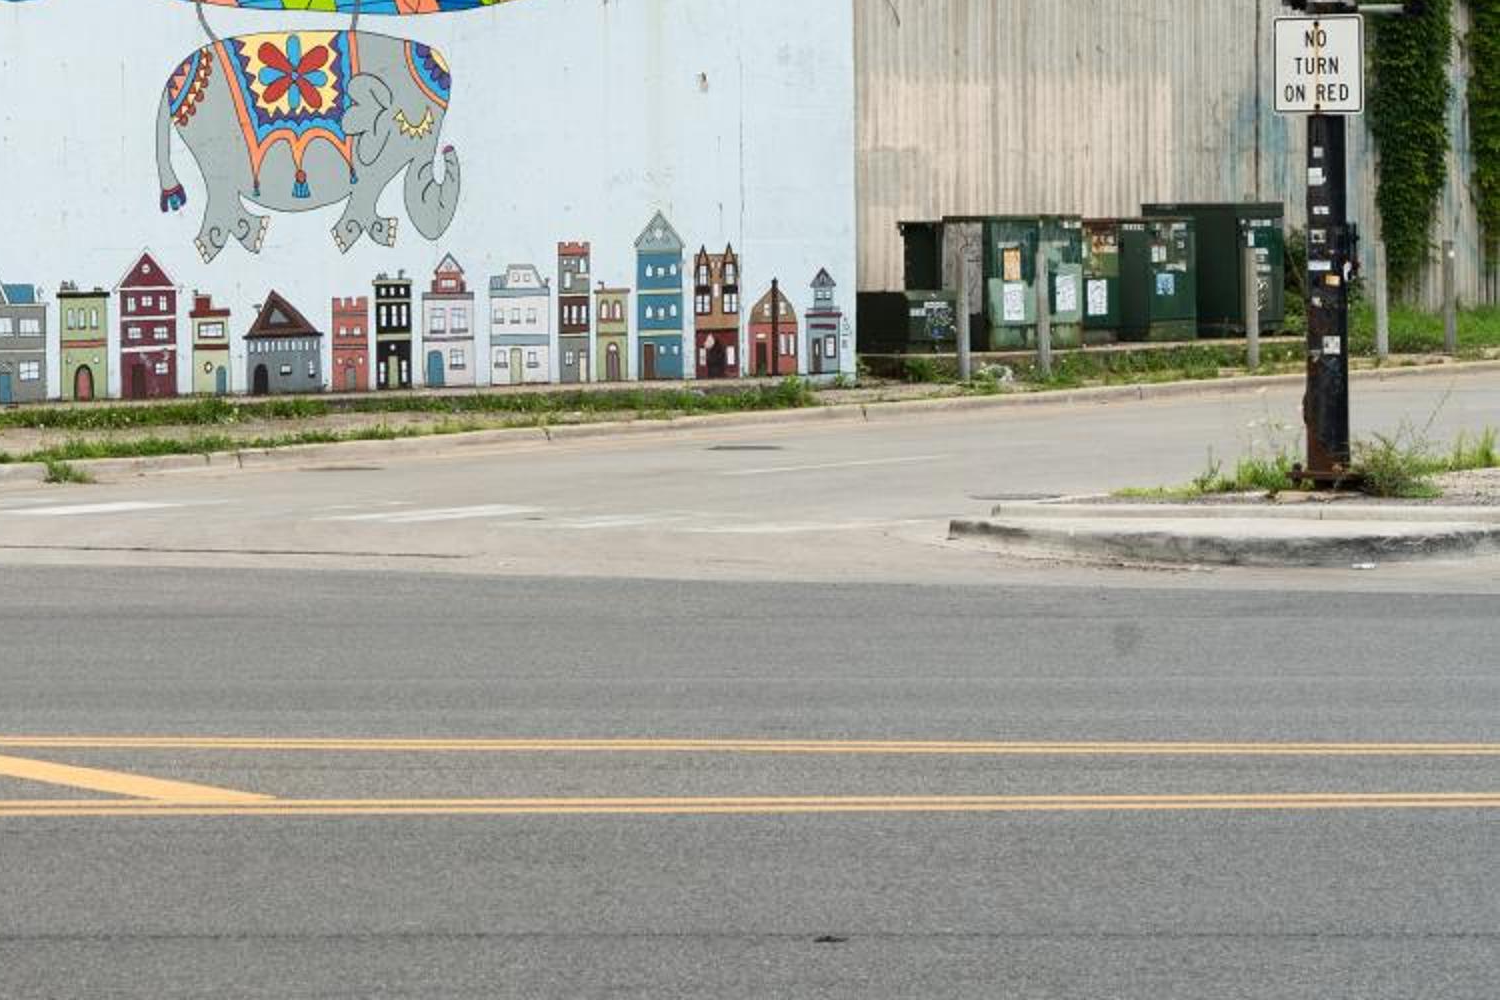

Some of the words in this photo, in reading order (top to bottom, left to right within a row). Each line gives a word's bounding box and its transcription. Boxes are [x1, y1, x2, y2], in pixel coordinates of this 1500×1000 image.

[1304, 29, 1327, 48] NO
[1294, 56, 1339, 75] TURN
[1284, 83, 1305, 103] ON
[1316, 83, 1349, 102] RED
